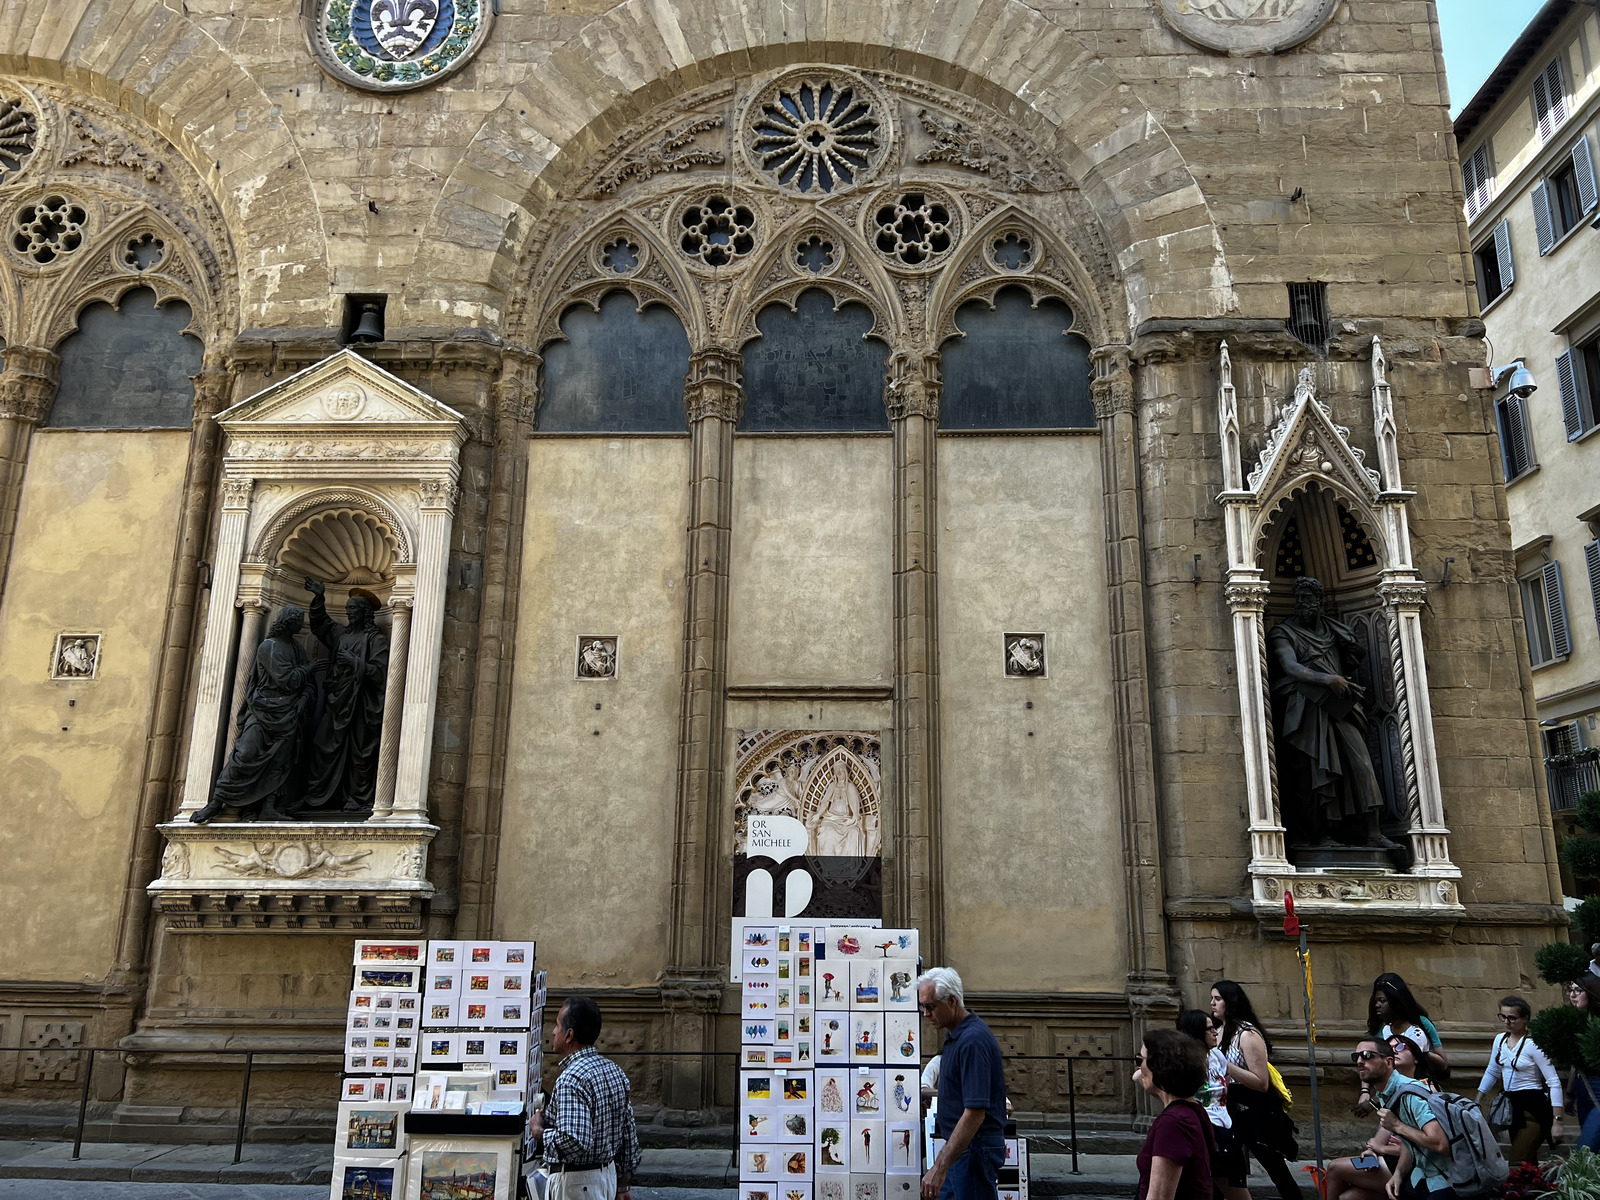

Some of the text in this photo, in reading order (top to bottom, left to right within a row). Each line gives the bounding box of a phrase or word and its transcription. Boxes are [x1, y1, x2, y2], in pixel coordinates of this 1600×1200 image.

[752, 820, 767, 828] OR
[752, 829, 771, 838] SAN
[751, 839, 791, 847] MICHELE
